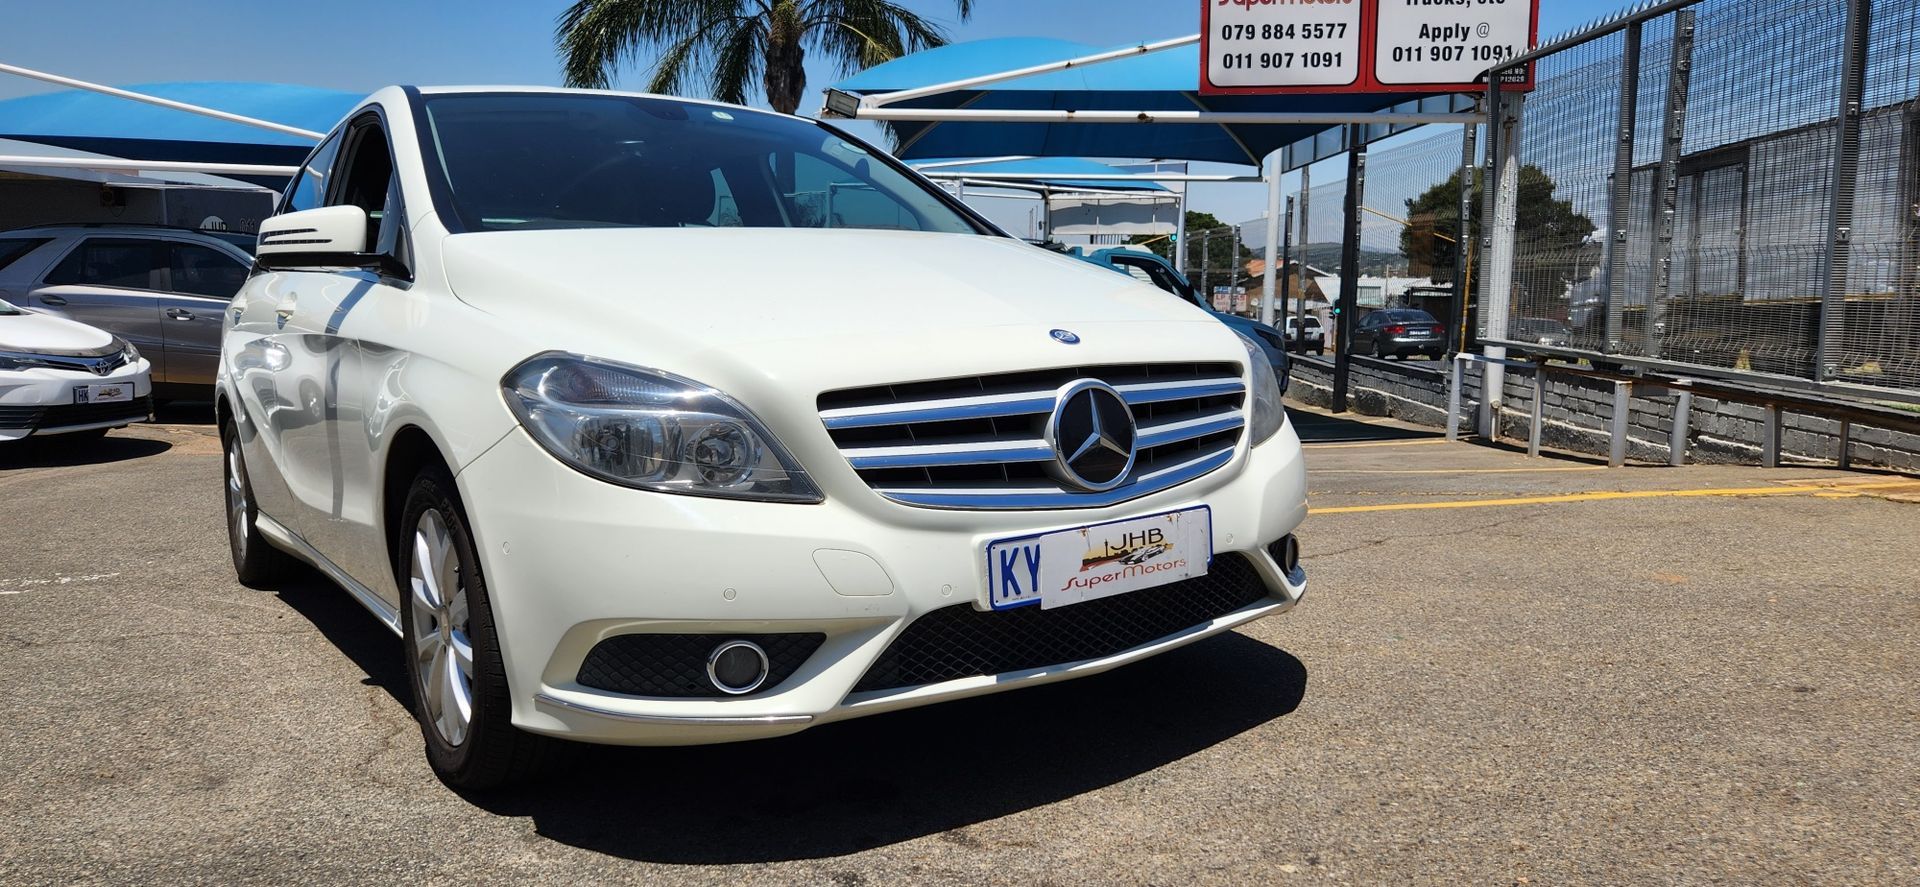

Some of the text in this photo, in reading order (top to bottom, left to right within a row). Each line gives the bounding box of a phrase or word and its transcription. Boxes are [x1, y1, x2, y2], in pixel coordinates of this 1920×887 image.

[1222, 23, 1347, 40] 079 884 5577
[1419, 22, 1490, 42] Apply @
[1223, 52, 1342, 69] 011 907 1091
[1392, 45, 1512, 62] 011 907 1091
[1110, 527, 1164, 550] JHB
[1001, 544, 1040, 598] KY
[1061, 558, 1187, 592] SuperMotors
